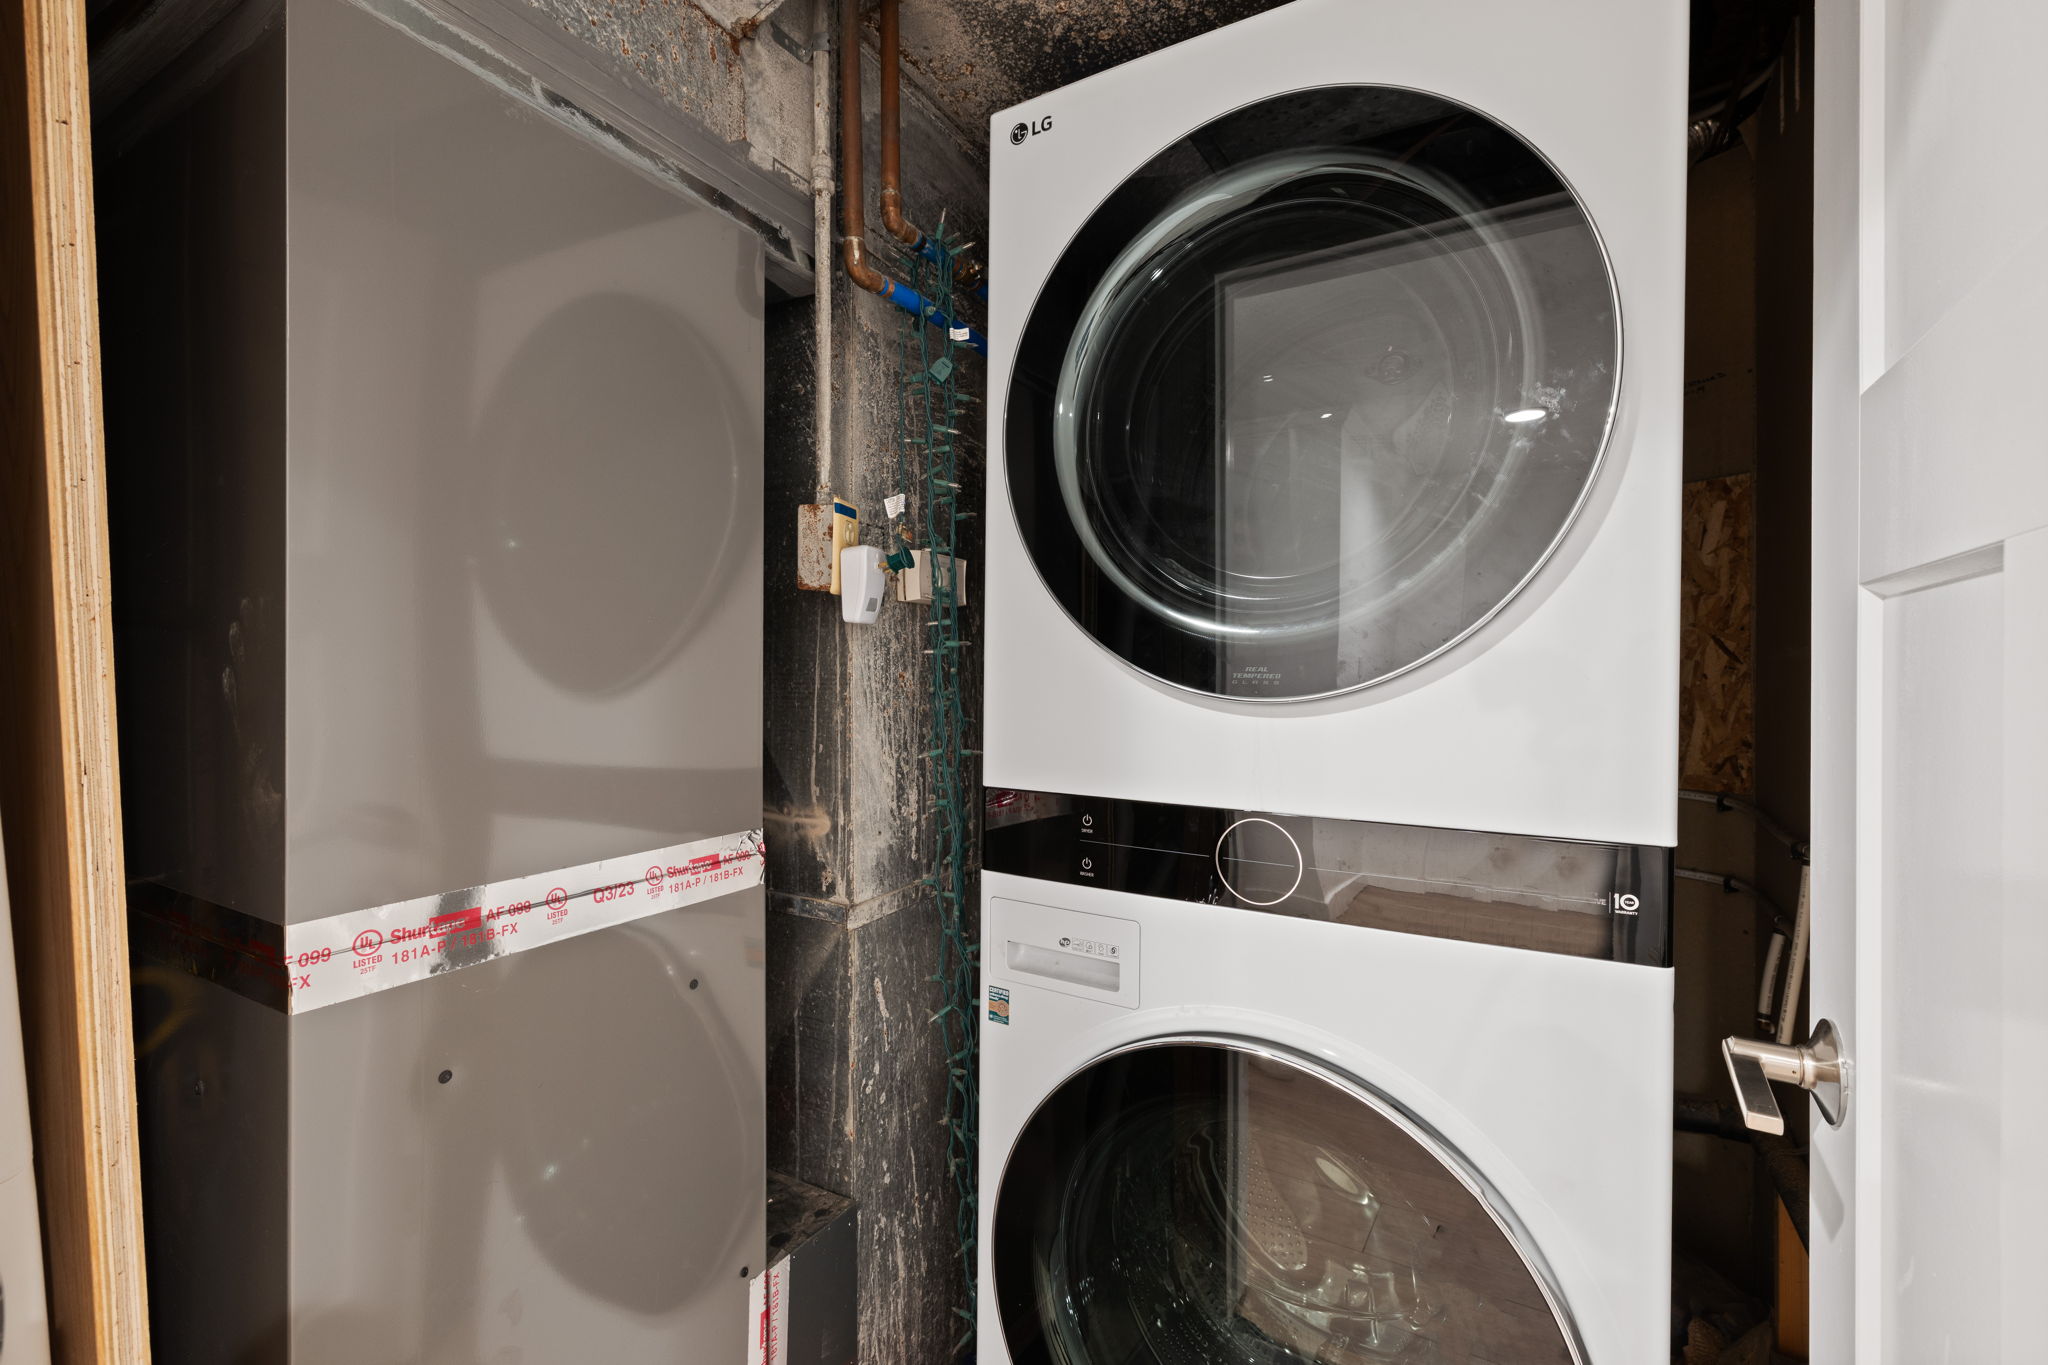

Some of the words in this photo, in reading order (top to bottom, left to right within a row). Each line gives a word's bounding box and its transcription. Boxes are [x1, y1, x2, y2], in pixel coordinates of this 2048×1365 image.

[1032, 116, 1052, 136] LG
[647, 885, 664, 895] LISTED
[669, 877, 701, 894] 181A-P
[709, 866, 744, 883] 181B-FX
[593, 881, 635, 904] Q3/23
[1614, 893, 1639, 911] 10
[486, 905, 505, 922] AF
[508, 900, 532, 917] 099
[547, 909, 568, 920] LISTED
[392, 940, 447, 964] 181A-P
[460, 922, 519, 947] 181B-FX
[298, 947, 331, 967] 099
[353, 954, 383, 969] LISTED
